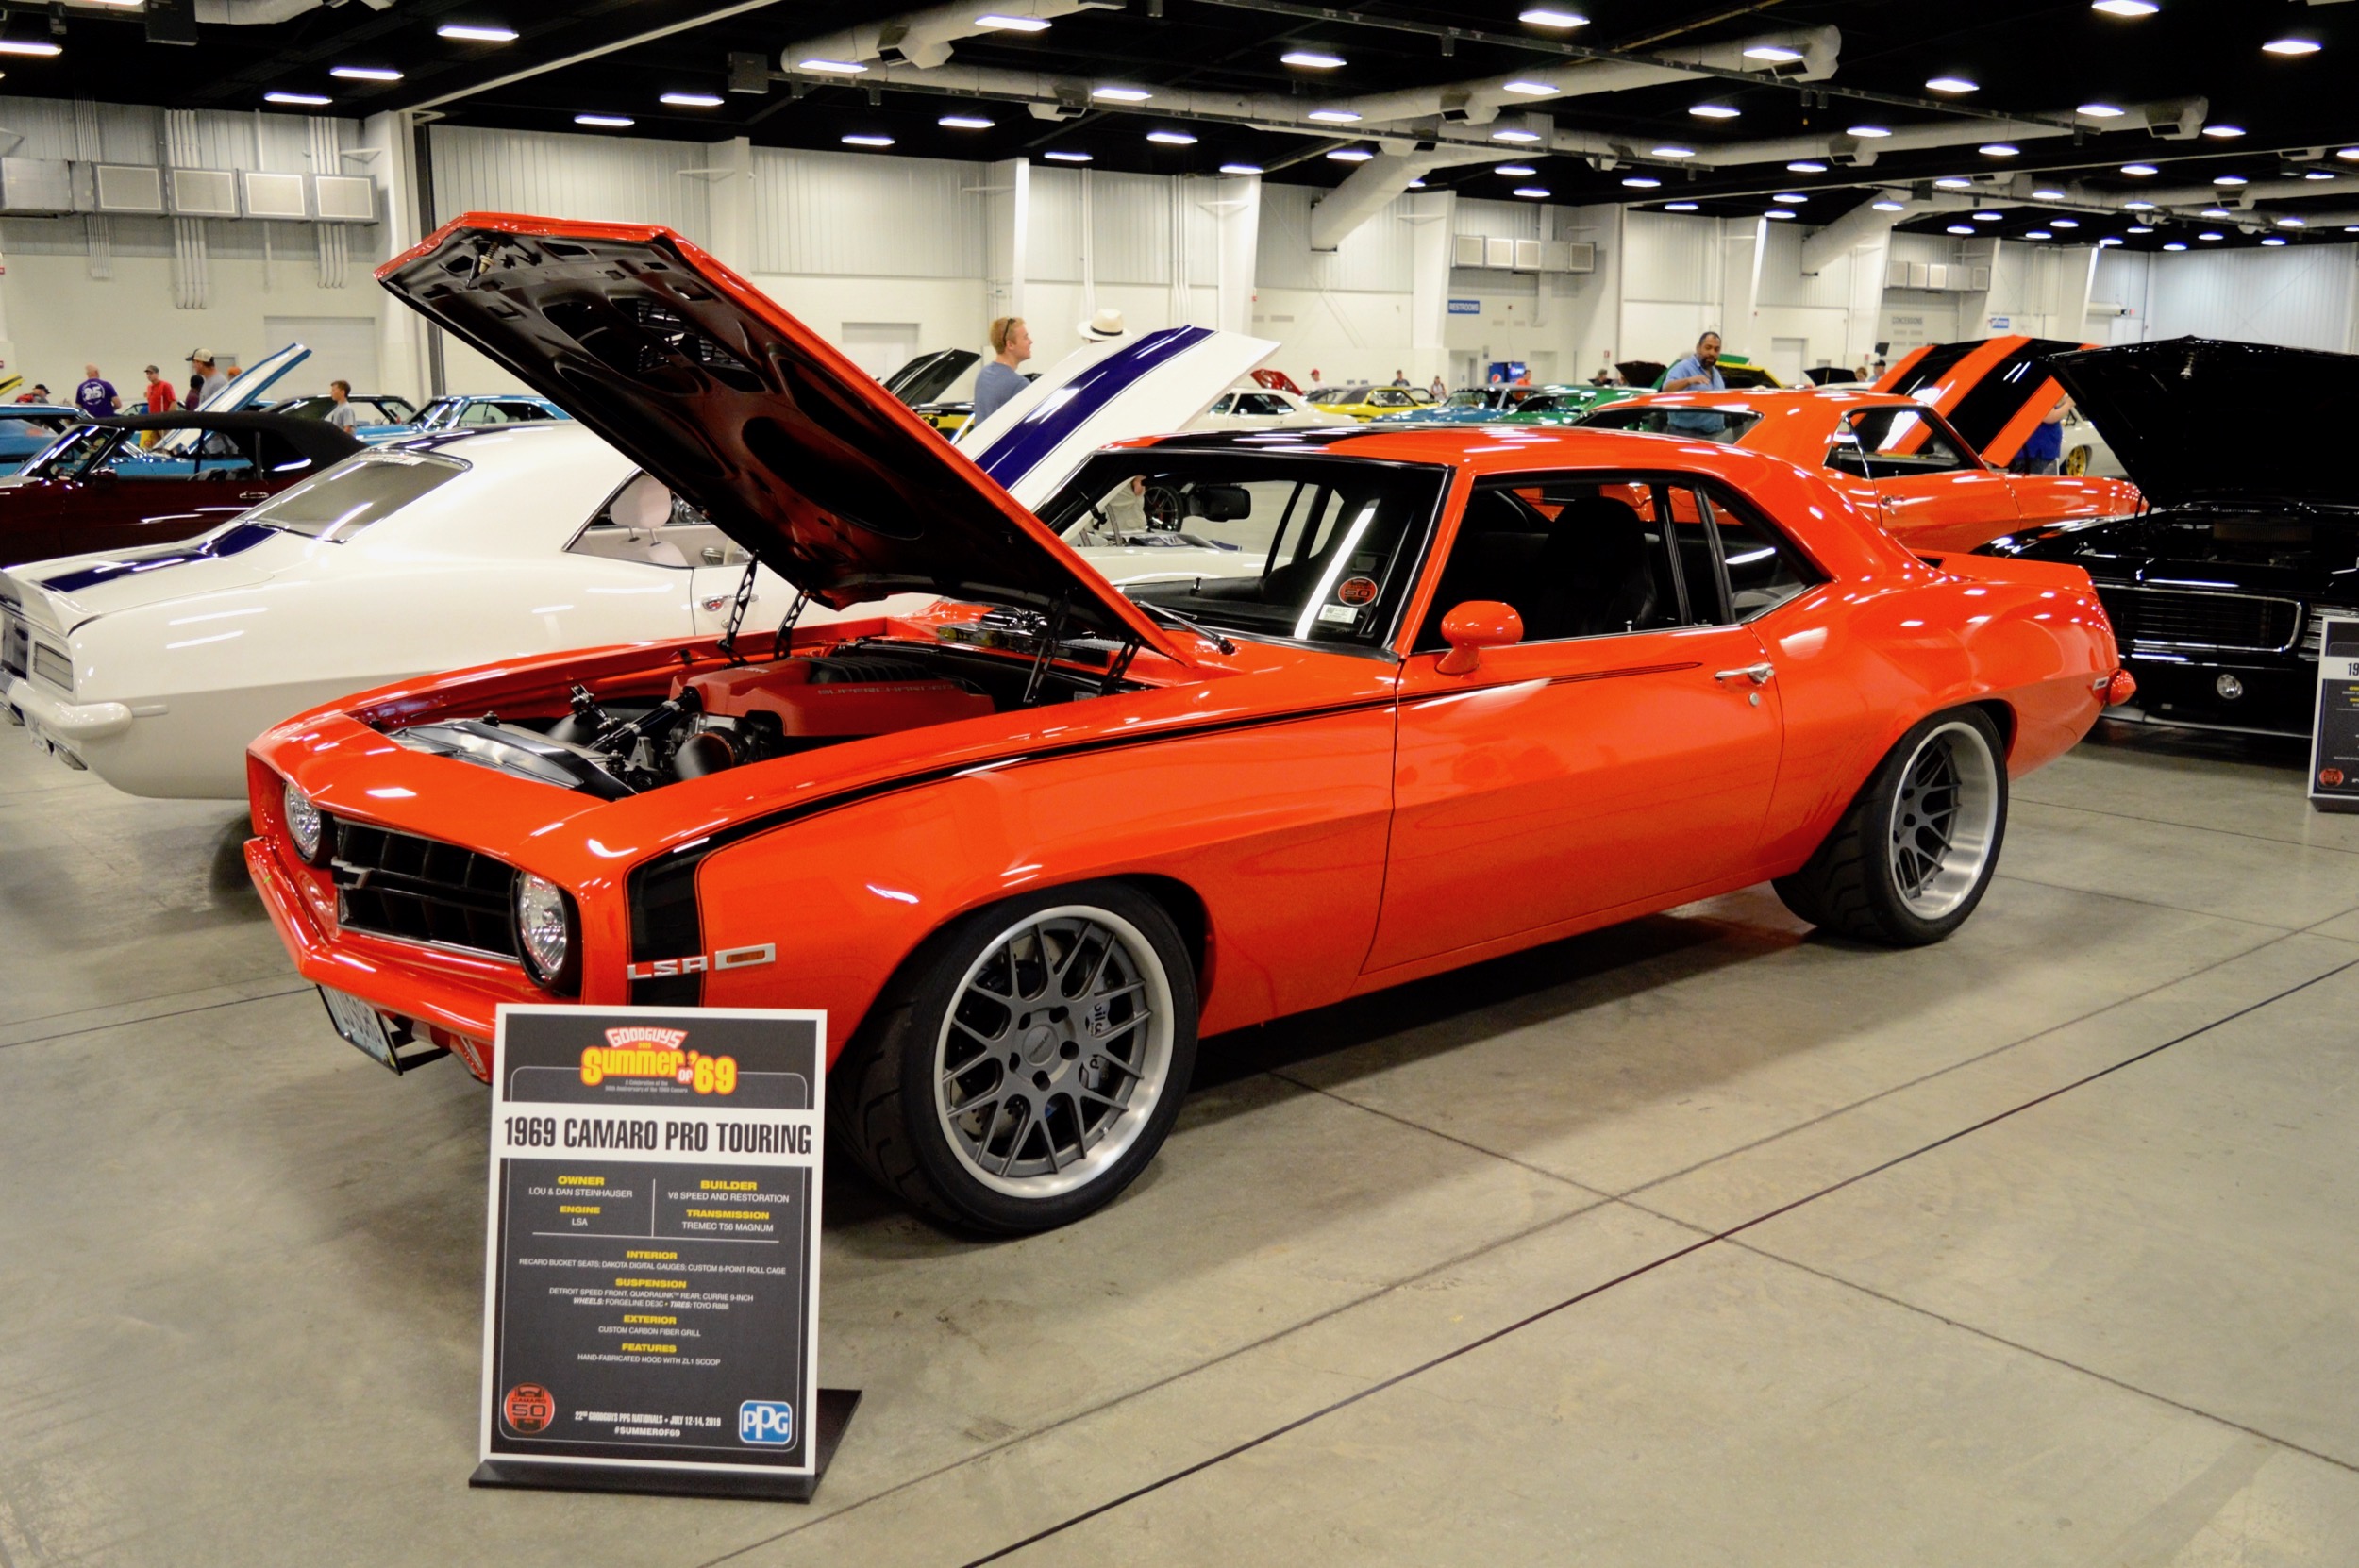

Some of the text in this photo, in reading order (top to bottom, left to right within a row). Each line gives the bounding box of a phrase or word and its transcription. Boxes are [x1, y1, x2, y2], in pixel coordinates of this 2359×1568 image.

[1344, 589, 1371, 597] 50
[627, 956, 708, 980] LSA
[605, 1027, 688, 1050] GOODGUYS
[581, 1047, 686, 1084] Summer
[678, 1068, 694, 1082] OF
[504, 1117, 811, 1154] 1969 CAMARO PRO TOURING
[558, 1176, 605, 1186] OWNER
[700, 1180, 758, 1191] BUILDER
[528, 1187, 633, 1198] LOU & DAN STEINHAUSER
[680, 1192, 709, 1201] SPEED
[711, 1193, 728, 1201] AND
[730, 1193, 790, 1203] RESTORATION
[560, 1206, 601, 1214] ENGINE
[686, 1209, 770, 1220] TRANSMISSION
[682, 1221, 774, 1232] TREMEC T56 MAGNUM
[627, 1250, 678, 1259] INTERIOR
[549, 1259, 577, 1267] BUCKET
[602, 1260, 628, 1269] DAKOTA
[629, 1261, 655, 1270] DIGITAL
[688, 1263, 717, 1272] CUSTOM
[747, 1265, 765, 1274] ROLL
[766, 1266, 786, 1275] CAGE
[615, 1278, 687, 1289] SUSPENSION
[549, 1287, 578, 1295] DETROIT
[702, 1293, 729, 1301] CURRIE
[730, 1293, 754, 1302] 9-INCH
[605, 1297, 644, 1306] FORGELINE
[694, 1301, 711, 1309] TOYO
[623, 1314, 677, 1325] EXTERIOR
[598, 1326, 701, 1337] CUSTOM CARBON FIBER GRILL
[622, 1343, 677, 1353] FEATURES
[577, 1354, 721, 1366] HAND-FABRICATED HOOD WITH ZL1 SCOOP
[512, 1403, 547, 1417] 50
[589, 1411, 618, 1423] GOODGUYS
[619, 1412, 631, 1423] PPG
[631, 1413, 663, 1425] NATIONALS
[669, 1415, 684, 1426] JULY
[705, 1417, 721, 1427] 2019
[743, 1405, 789, 1439] PPG
[614, 1426, 681, 1438] #SUMMEROF69
